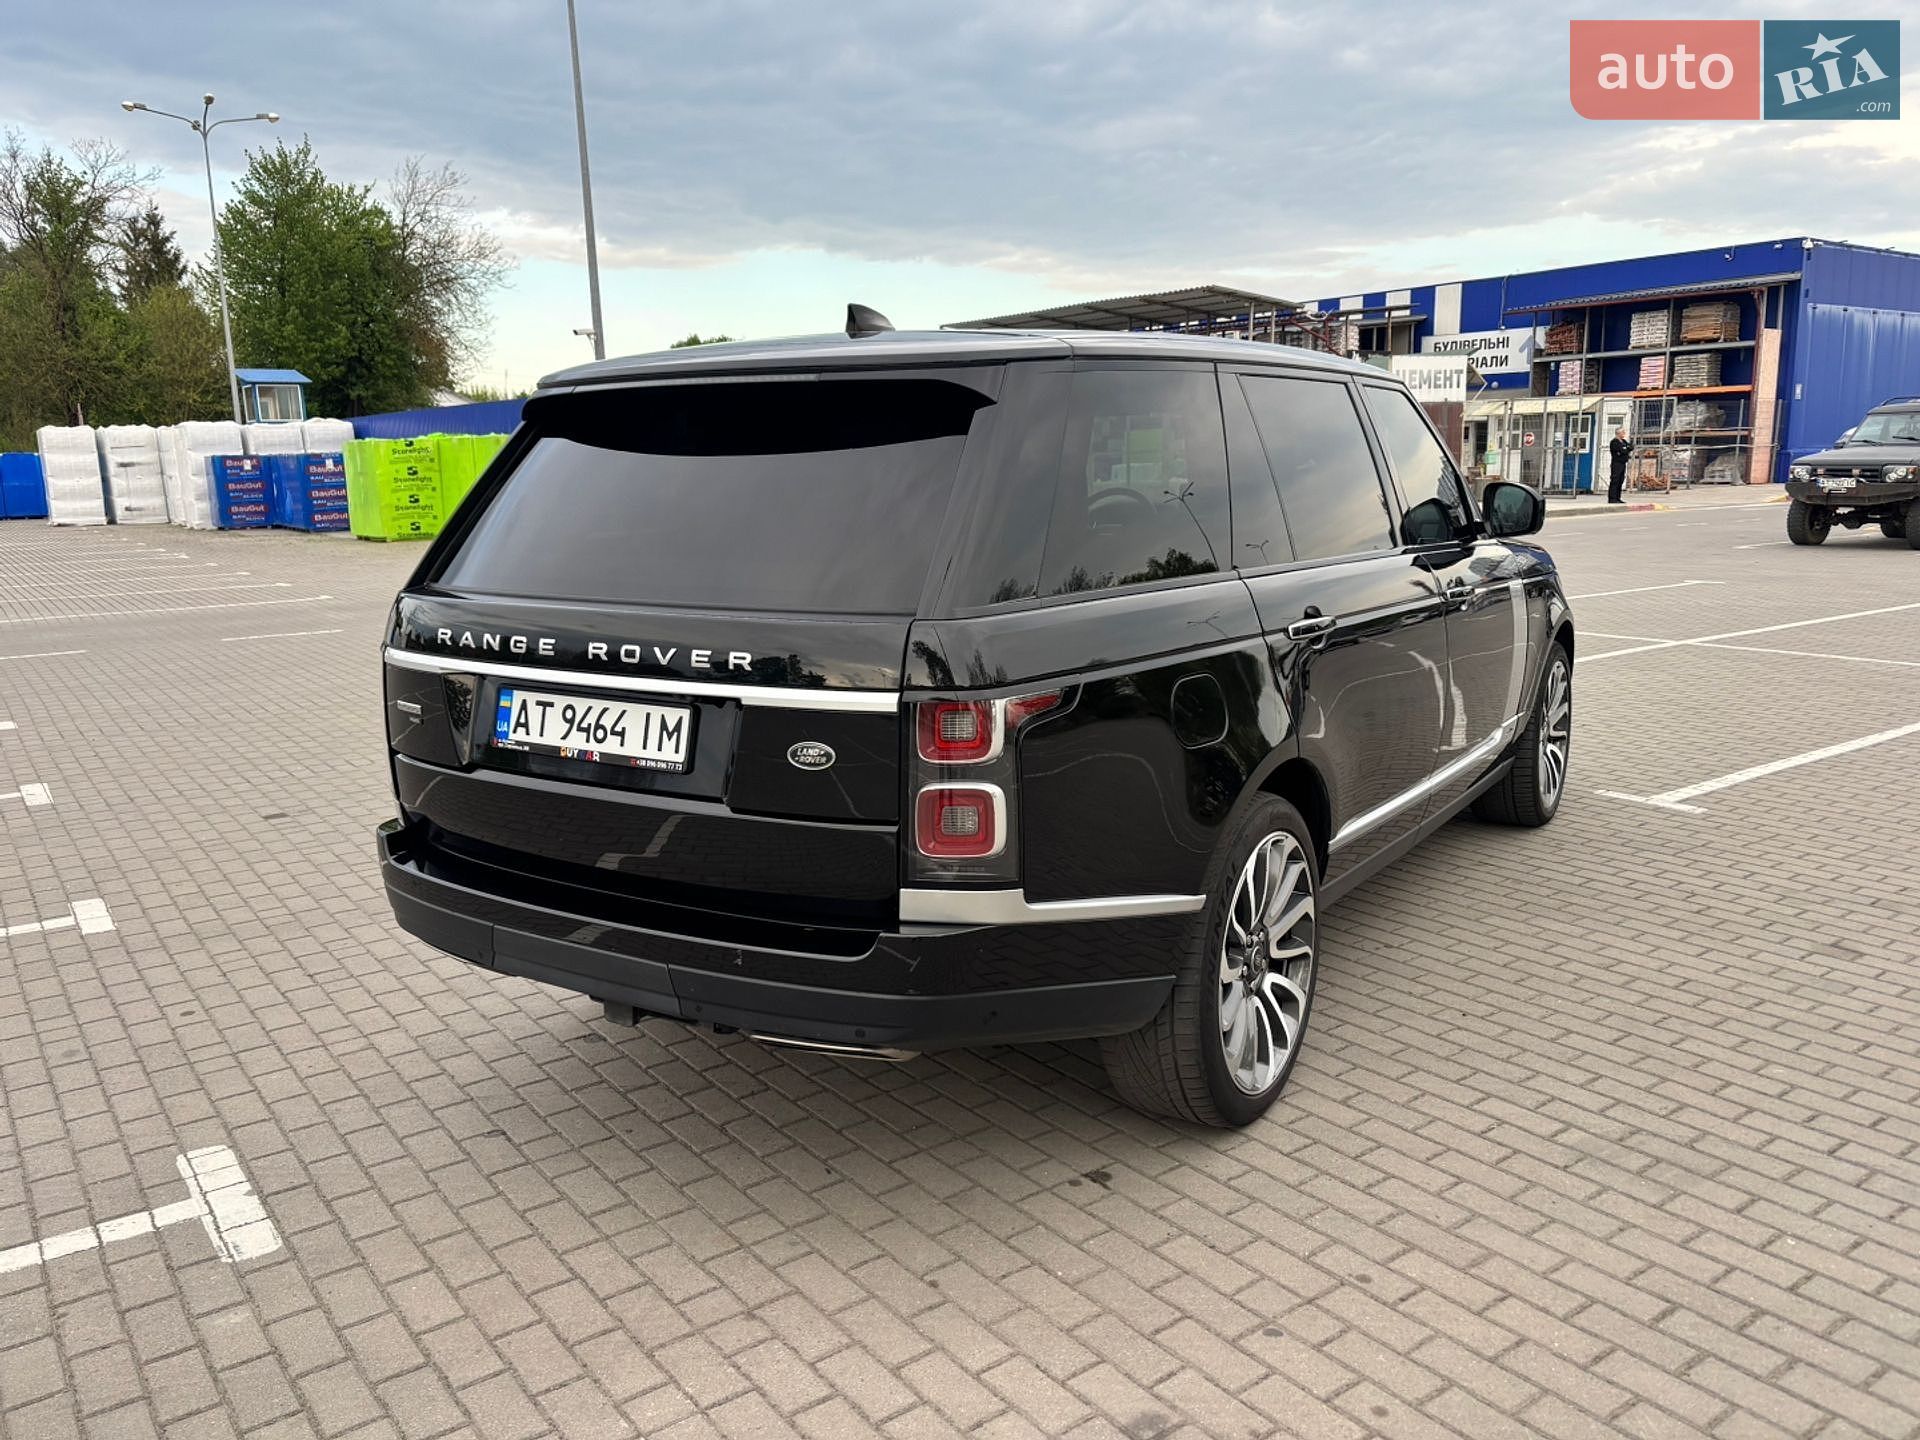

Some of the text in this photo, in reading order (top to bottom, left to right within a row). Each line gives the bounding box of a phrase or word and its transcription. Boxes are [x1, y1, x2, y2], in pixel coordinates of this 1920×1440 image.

[1467, 354, 1509, 369] РІАЛИ
[225, 459, 258, 467] Bauut
[437, 628, 753, 671] RANGE ROVER
[496, 720, 509, 734] UA
[512, 698, 684, 755] AT 9464 IM
[797, 747, 820, 756] LAND
[798, 756, 827, 764] ROVER
